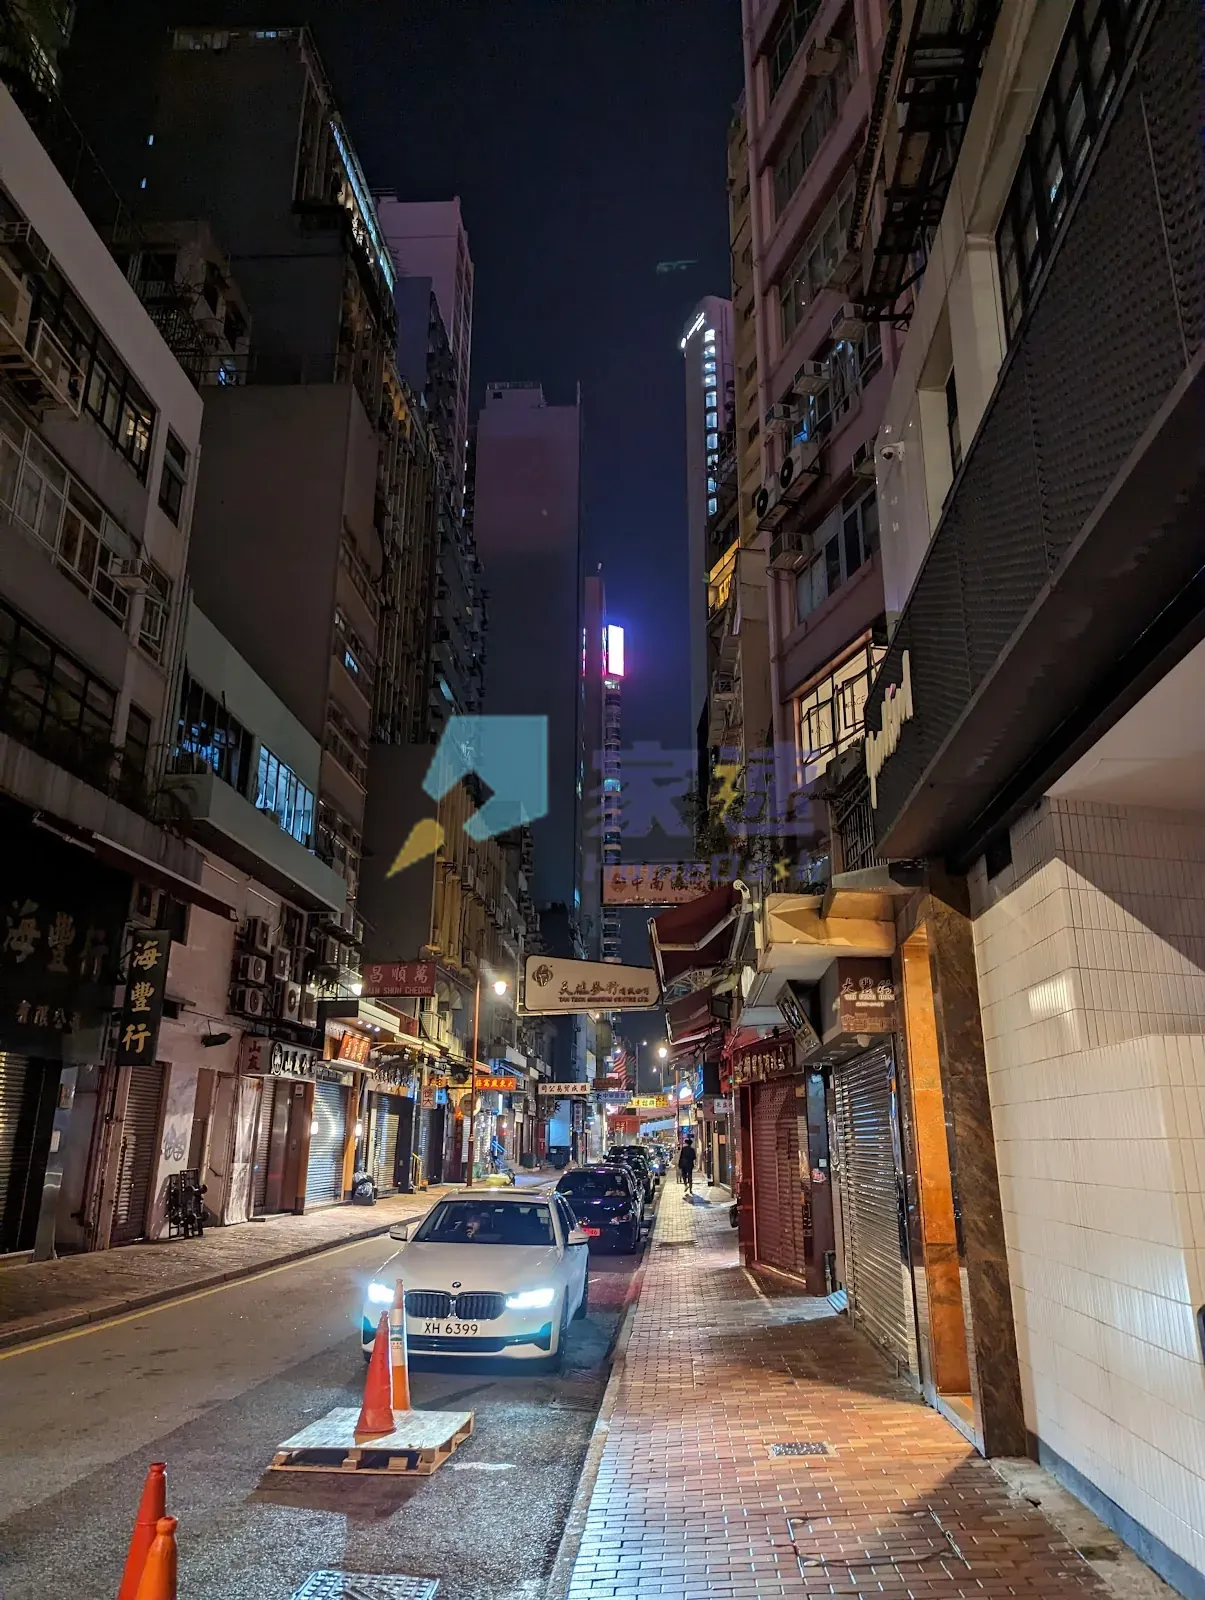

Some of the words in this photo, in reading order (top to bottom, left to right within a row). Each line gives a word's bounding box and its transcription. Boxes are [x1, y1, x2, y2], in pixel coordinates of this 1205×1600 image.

[405, 986, 432, 994] CHEONG
[121, 940, 162, 1053] 海豐行
[424, 1322, 440, 1334] XH
[445, 1323, 478, 1334] 6399
